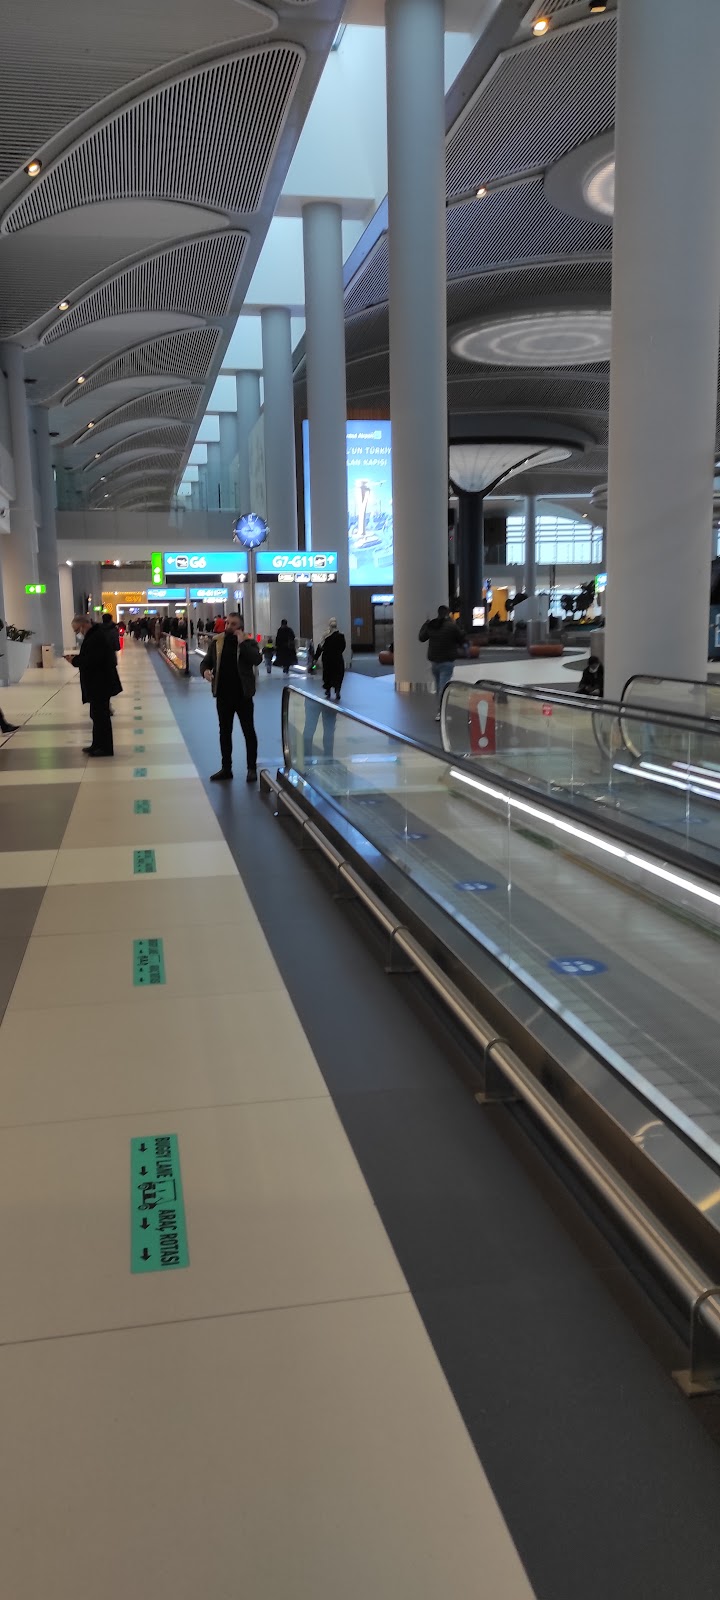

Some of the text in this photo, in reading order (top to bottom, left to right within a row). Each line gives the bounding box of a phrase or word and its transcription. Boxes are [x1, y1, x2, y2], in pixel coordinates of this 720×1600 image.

[189, 556, 207, 568] G6
[272, 555, 314, 568] G7-G11
[156, 1159, 173, 1178] LANE
[155, 1209, 180, 1266] ARAÇ ROTASI
